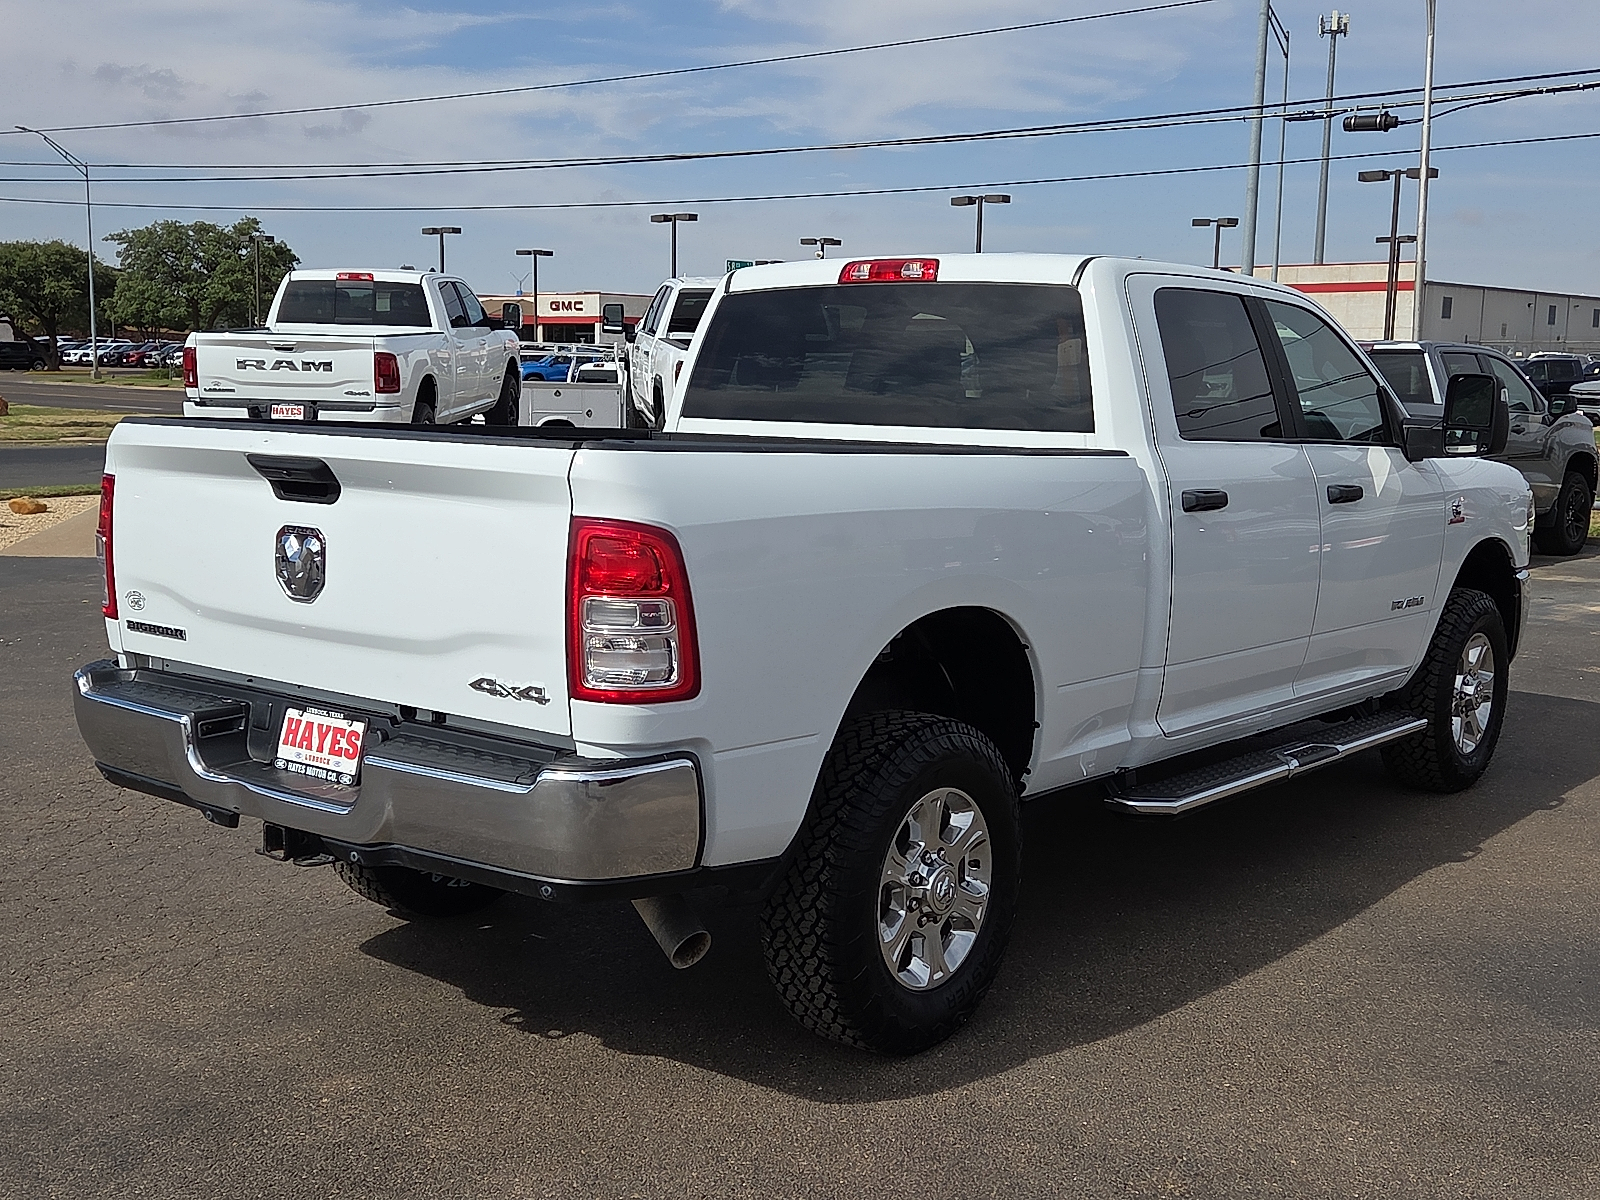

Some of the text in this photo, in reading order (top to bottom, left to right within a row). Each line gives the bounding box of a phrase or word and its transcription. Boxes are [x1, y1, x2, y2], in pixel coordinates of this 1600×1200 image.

[549, 300, 584, 312] GMC
[235, 358, 333, 373] RAM
[272, 406, 303, 416] HAYES
[282, 717, 361, 760] HAYES
[305, 754, 330, 765] LUBBOCK
[287, 762, 306, 774] HAYES
[306, 766, 327, 780] MOTOR
[327, 771, 338, 782] CO.
